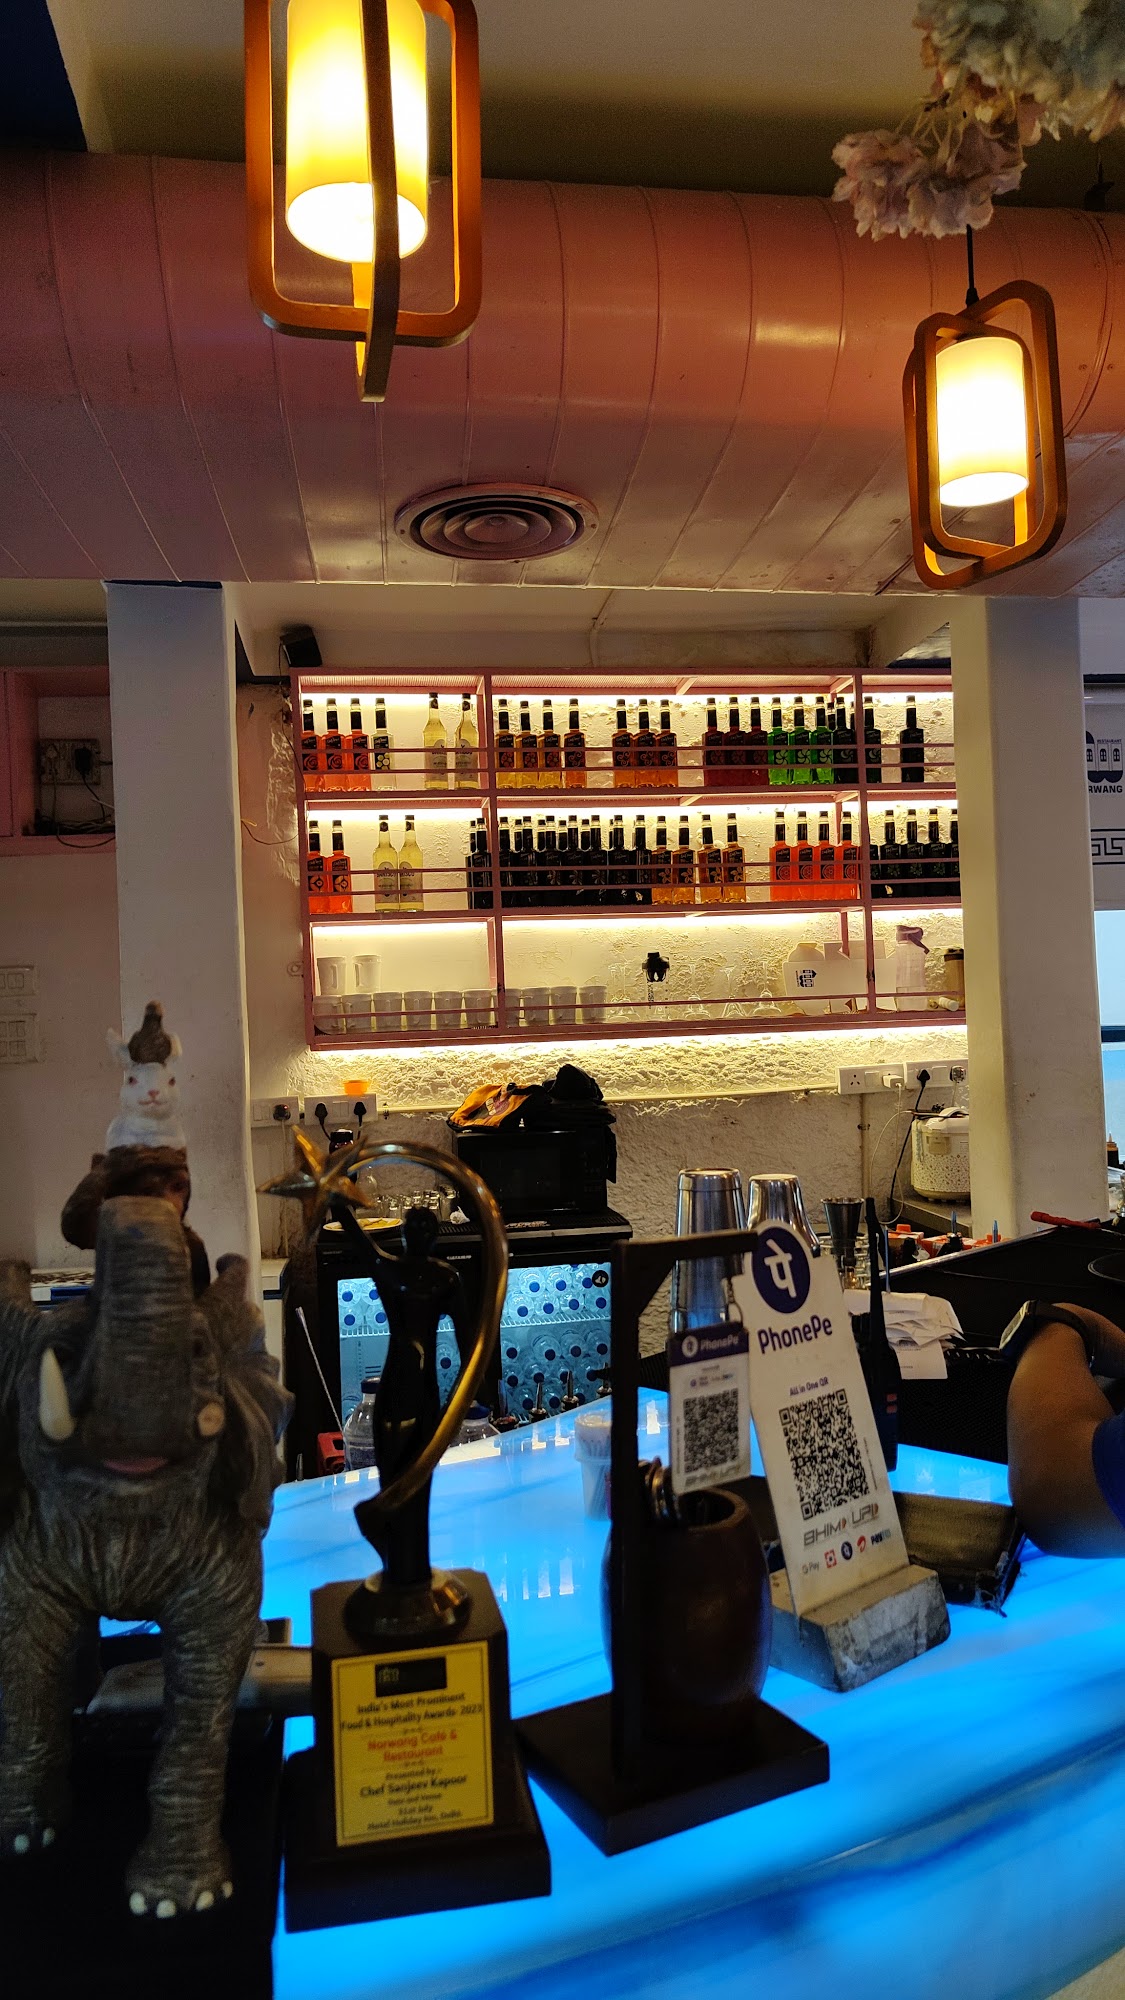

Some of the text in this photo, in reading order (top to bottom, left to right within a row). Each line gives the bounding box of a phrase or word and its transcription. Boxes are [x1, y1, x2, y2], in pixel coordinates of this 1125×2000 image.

[700, 1334, 739, 1351] PhonePe
[757, 1314, 833, 1354] PhonePe
[789, 1385, 799, 1396] All
[806, 1380, 819, 1391] One
[819, 1376, 829, 1386] QR
[803, 1520, 842, 1547] BHIM
[851, 1503, 875, 1525] UPI
[358, 1692, 465, 1714] India's Most Prominent
[339, 1720, 363, 1731] Food
[365, 1719, 372, 1728] &
[374, 1711, 421, 1728] Hospitality
[424, 1706, 456, 1719] Awards
[360, 1774, 467, 1798] Chef Sanjeev Kapoor
